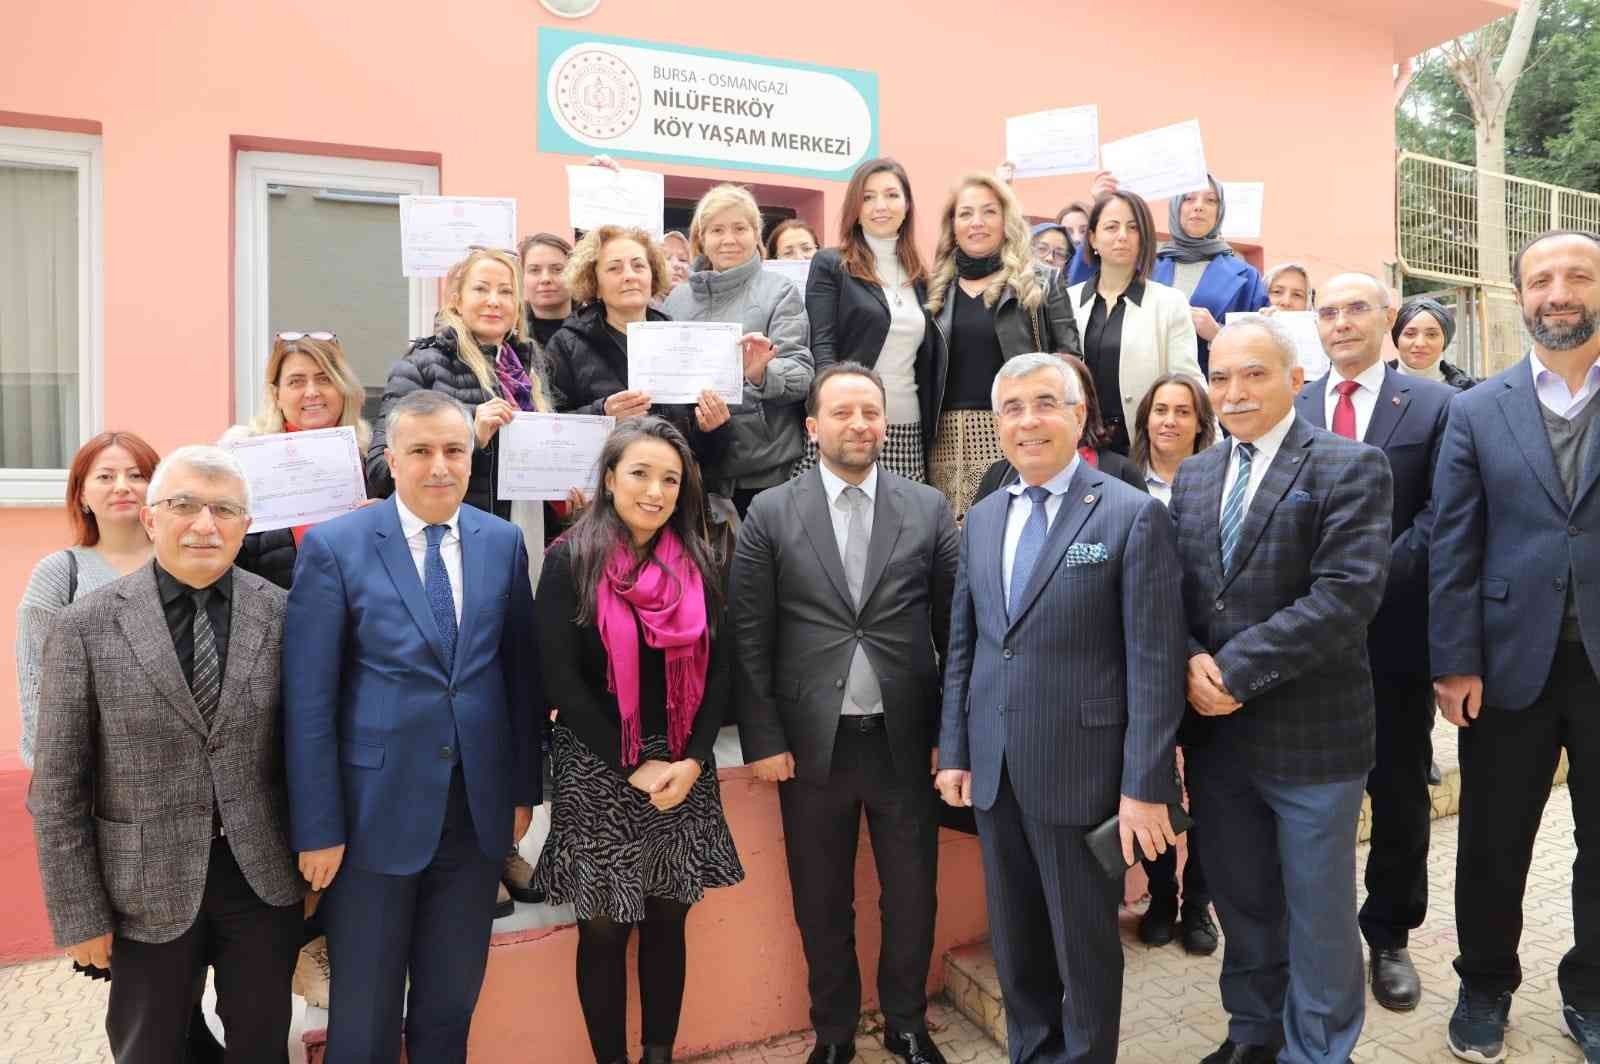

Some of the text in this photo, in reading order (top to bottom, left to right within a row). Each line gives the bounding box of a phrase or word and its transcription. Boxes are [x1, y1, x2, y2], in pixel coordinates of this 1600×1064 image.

[653, 65, 697, 83] BURSA
[708, 73, 788, 96] OSMANGAZİ
[654, 87, 775, 119] NİLÜFERKÖY
[654, 116, 851, 156] KÖY YAŞAM MERKEZİ
